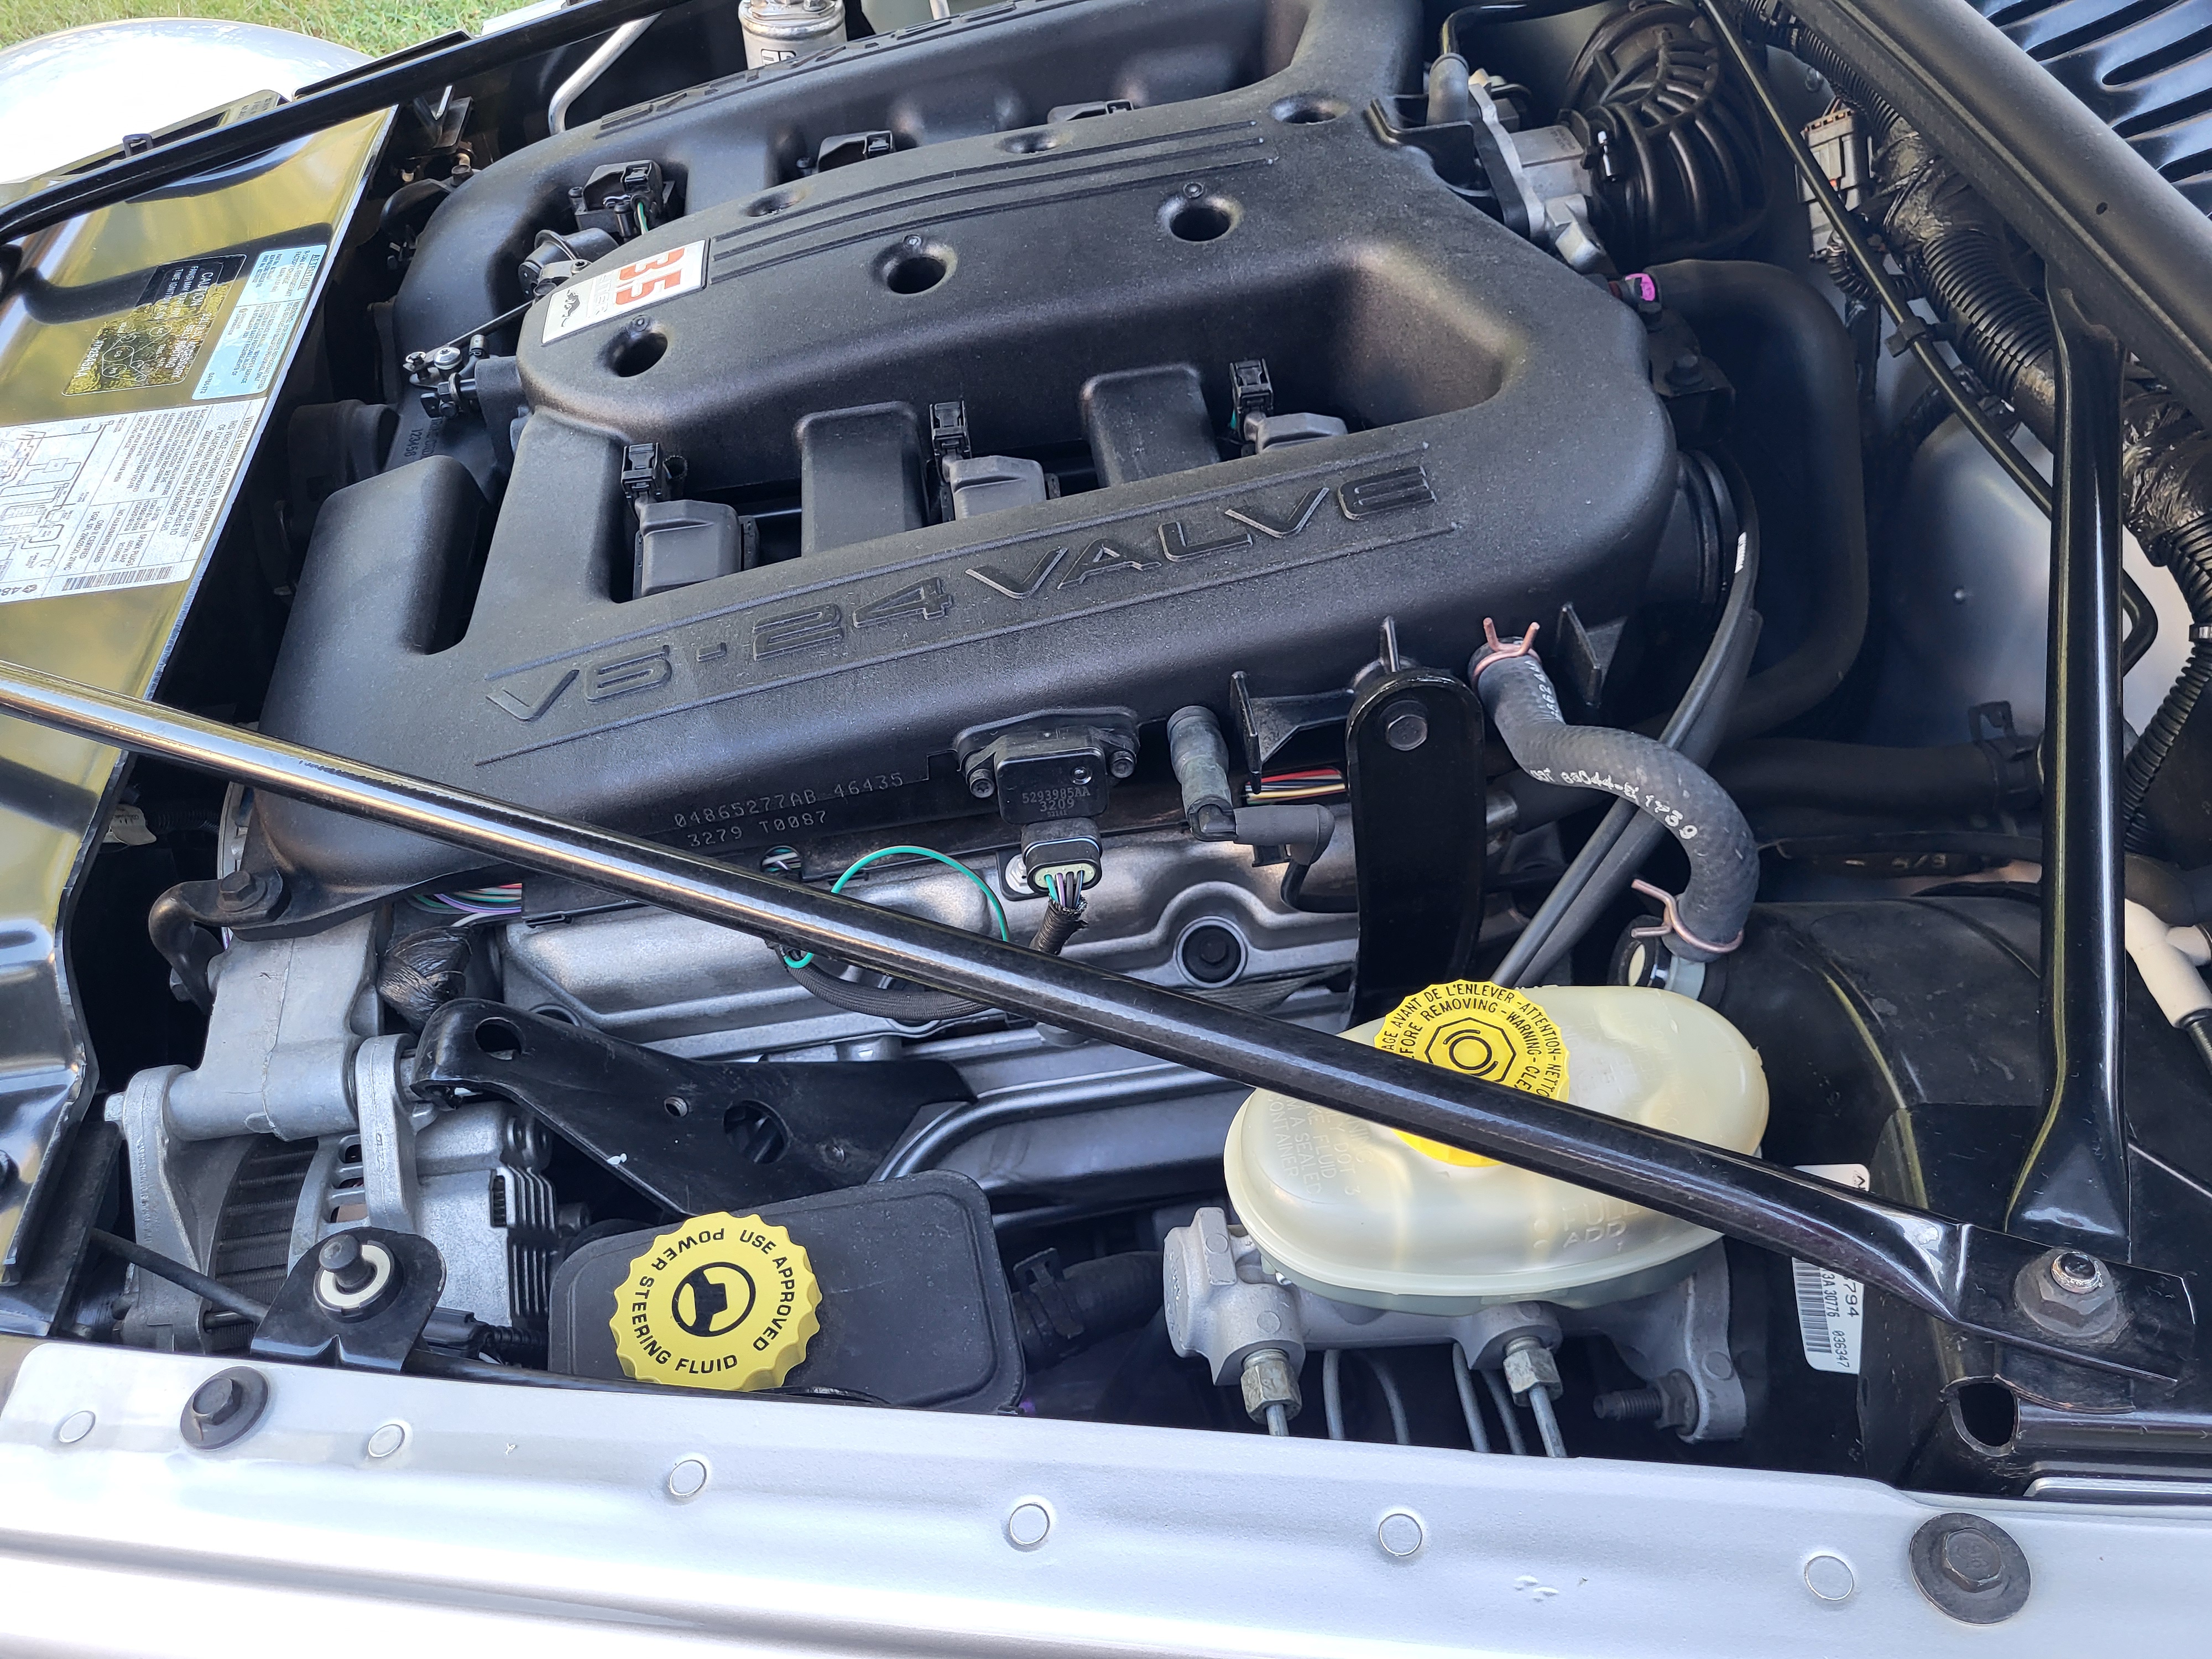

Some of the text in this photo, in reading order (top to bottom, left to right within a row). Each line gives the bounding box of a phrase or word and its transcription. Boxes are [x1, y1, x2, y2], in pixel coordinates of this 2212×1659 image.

[170, 268, 184, 280] TIME
[189, 272, 214, 307] CAUTION
[192, 442, 208, 459] MODEL
[202, 431, 223, 461] CALIFORNIA
[186, 460, 199, 473] YEAR
[186, 461, 210, 495] REGULATIONS
[191, 416, 254, 542] VEHICLE EMISSION CONTROL INFORMATION
[166, 486, 187, 515] PASSENGER
[171, 496, 194, 527] APPLICABLE
[77, 535, 97, 559] CERTIFIED
[674, 772, 904, 828] 04865277AB 46435
[1040, 799, 1074, 812] 3209
[687, 810, 826, 848] 3279 T0087
[1391, 998, 1422, 1029] AVANT
[1424, 988, 1442, 1003] DE
[1400, 1022, 1423, 1058] FORE
[1421, 998, 1498, 1021] REMOVING
[1295, 1132, 1322, 1194] SEALED
[1313, 1134, 1337, 1179] FLUID
[632, 1228, 738, 1374] POWER STEERING FLUID
[739, 1229, 795, 1352] USE APPROVED
[1825, 1290, 1840, 1317] 30776
[1843, 1276, 1860, 1318] 794
[1832, 1329, 1850, 1369] 036347
